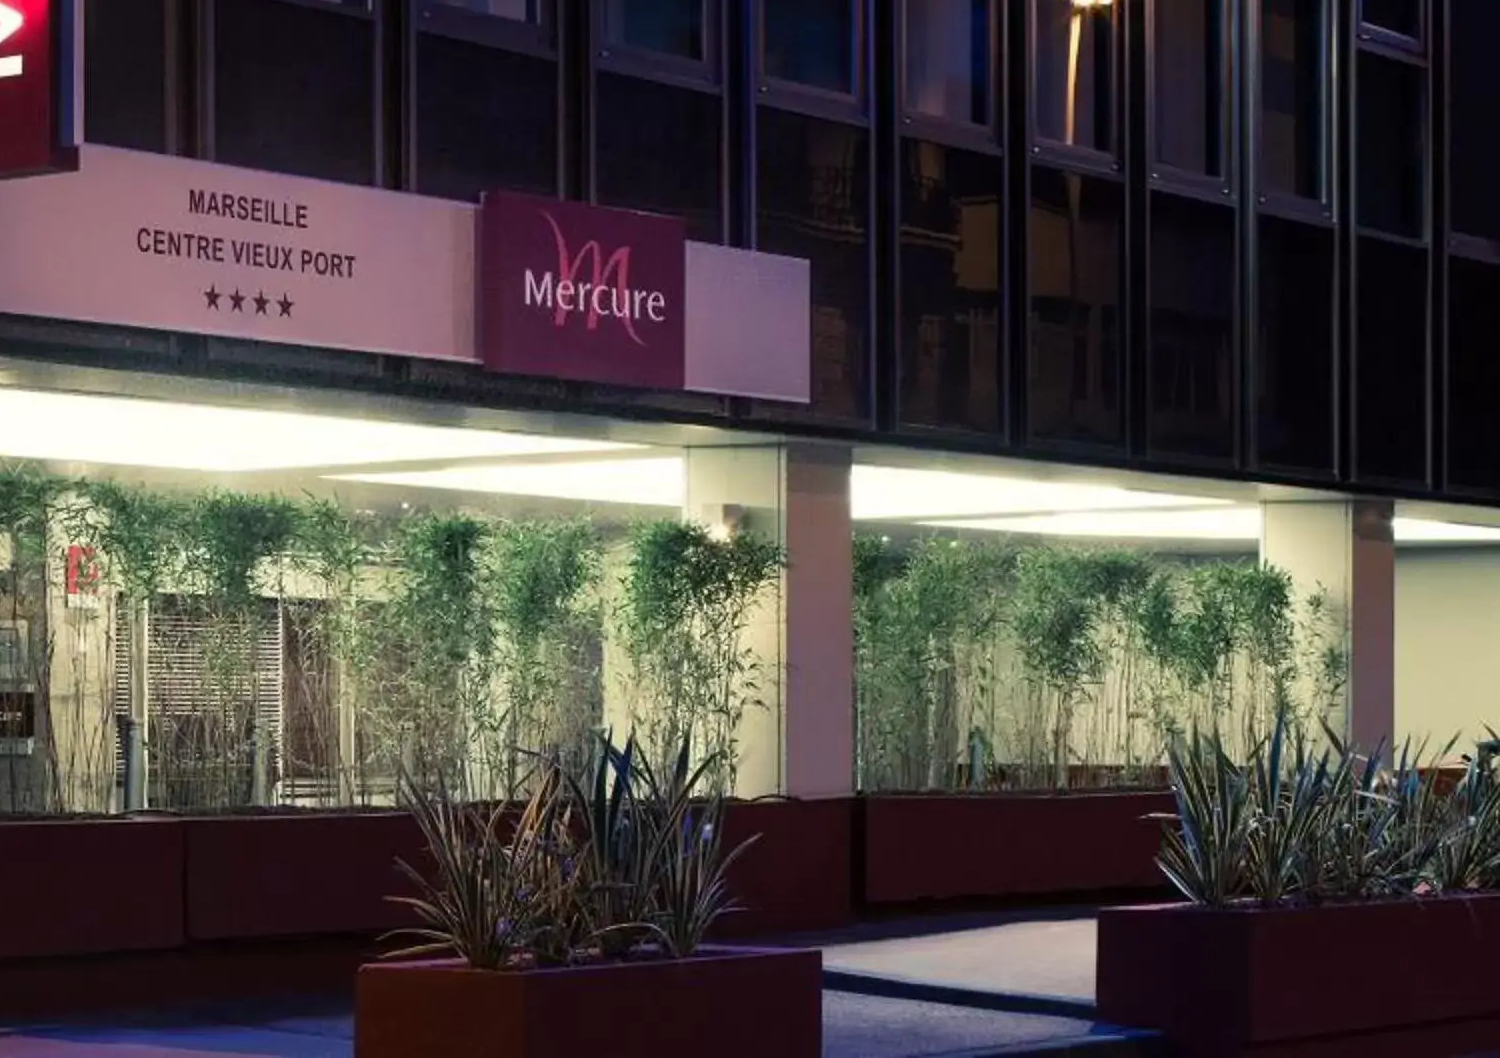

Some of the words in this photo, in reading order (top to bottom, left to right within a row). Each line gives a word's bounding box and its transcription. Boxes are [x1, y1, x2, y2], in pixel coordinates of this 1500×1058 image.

[188, 189, 309, 229] MARSEILLE
[136, 227, 225, 263] CENTRE
[231, 239, 294, 271] VIEUX
[300, 249, 357, 279] PORT
[523, 267, 666, 322] Mercure
